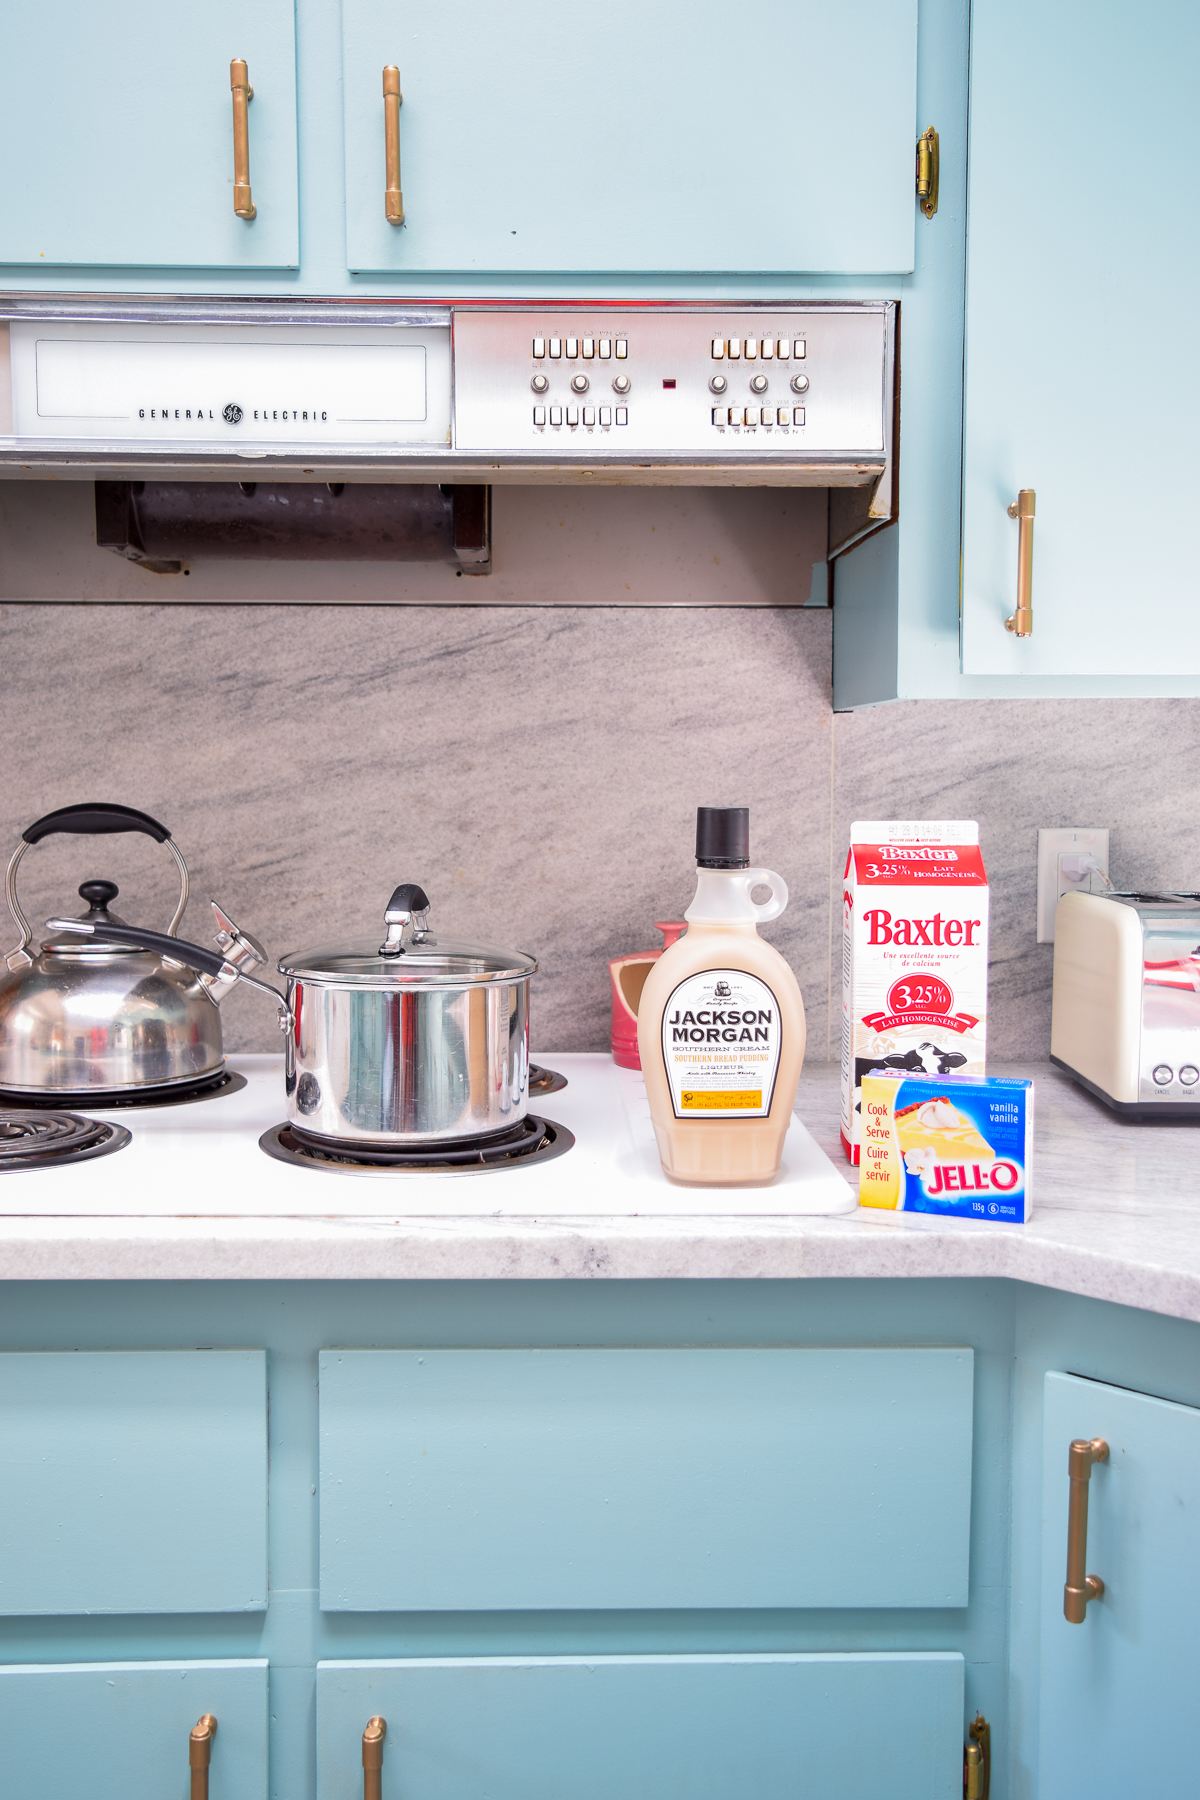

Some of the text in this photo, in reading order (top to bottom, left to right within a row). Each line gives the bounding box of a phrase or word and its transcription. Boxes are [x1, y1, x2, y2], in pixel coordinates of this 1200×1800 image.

[138, 409, 214, 419] GENERAL
[253, 410, 327, 421] ELECTRIC
[878, 847, 954, 861] Baxter
[865, 863, 911, 878] 3.25%
[863, 909, 981, 946] Baxter
[895, 985, 947, 1009] 3.25%
[669, 1010, 772, 1026] JACKSON
[881, 1017, 901, 1028] LAIT
[672, 1027, 769, 1043] MORGAN
[674, 1053, 769, 1063] SOUTHERN BREAD PUDDING
[867, 1102, 888, 1116] Cook
[990, 1103, 1018, 1113] vanilla
[875, 1117, 881, 1126] &
[990, 1113, 1018, 1124] vanille
[866, 1125, 890, 1139] Serve
[867, 1146, 889, 1159] Cuire
[873, 1161, 882, 1170] et
[866, 1170, 891, 1182] servir
[972, 1202, 984, 1213] 135g
